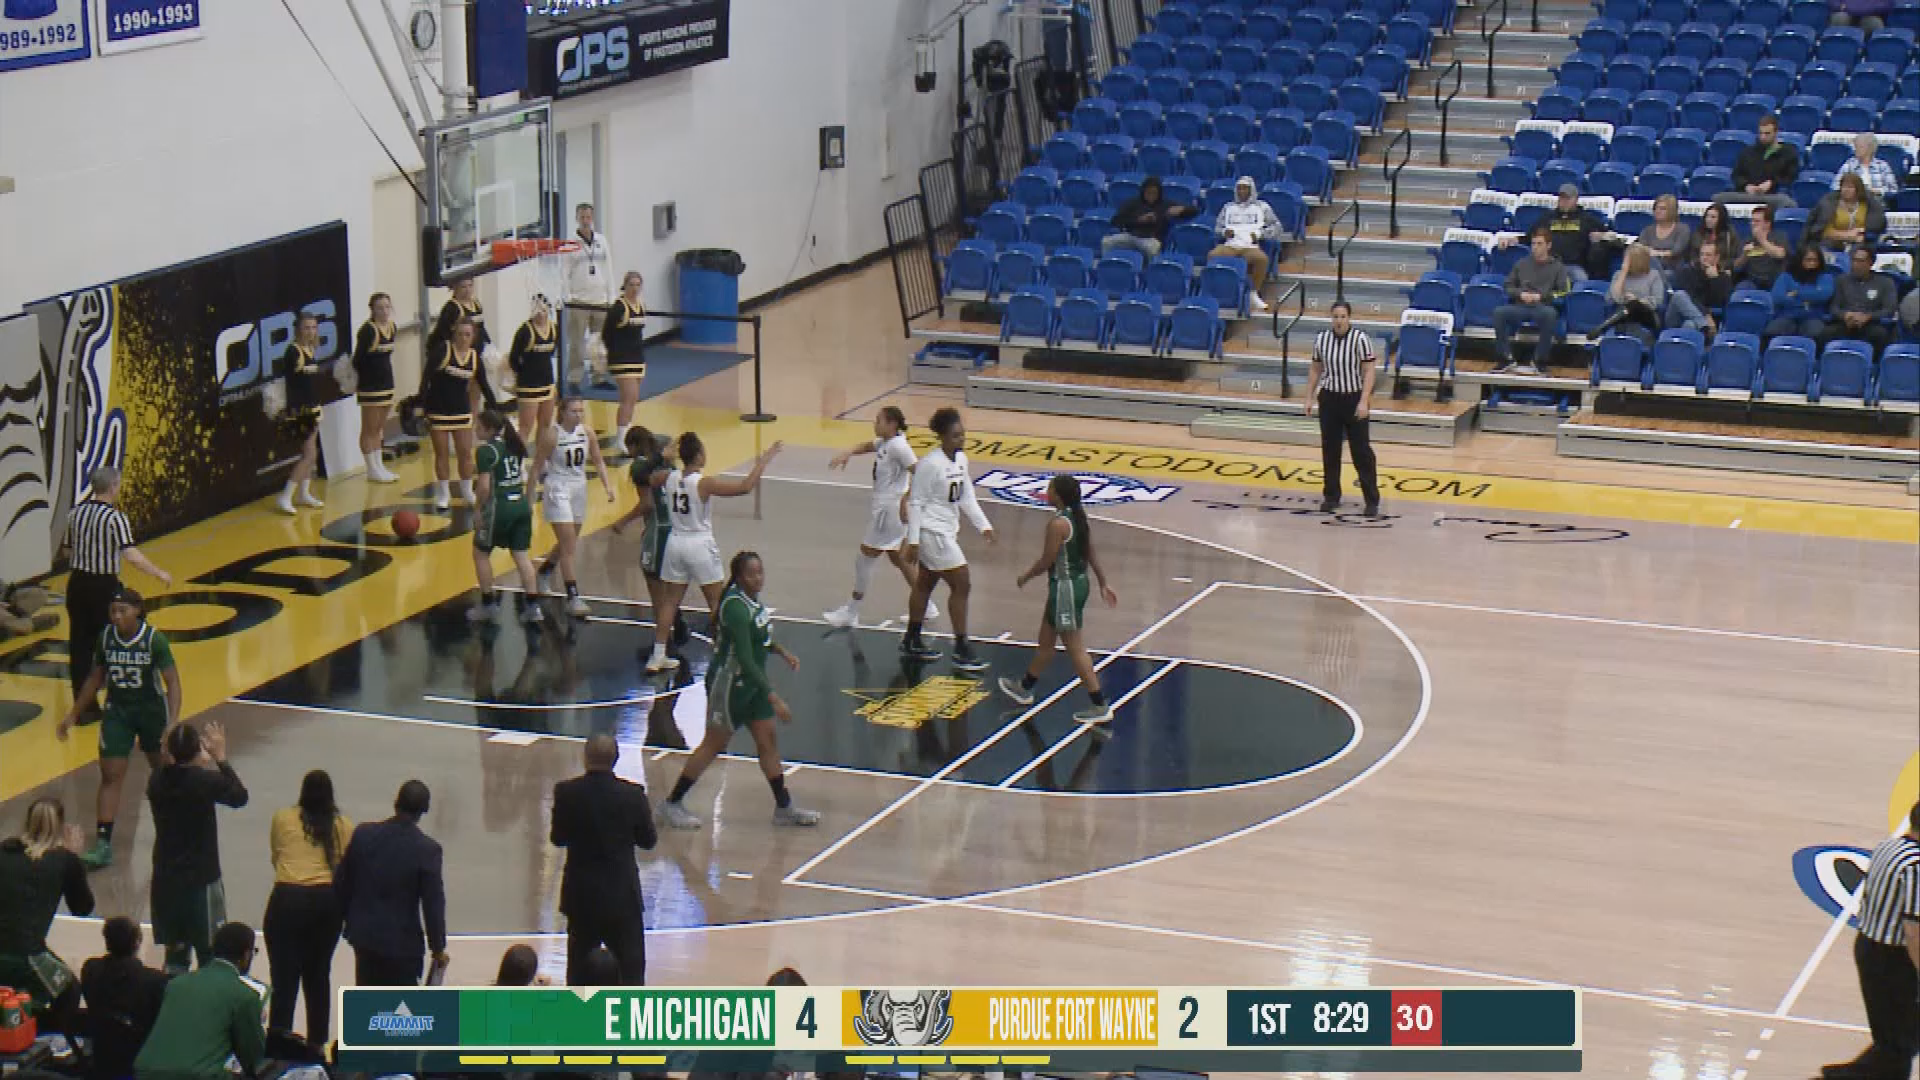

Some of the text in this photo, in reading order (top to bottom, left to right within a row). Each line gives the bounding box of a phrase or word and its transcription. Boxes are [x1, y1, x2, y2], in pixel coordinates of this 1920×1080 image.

[114, 4, 193, 33] 1990-1993
[556, 26, 630, 83] OPS
[503, 455, 520, 479] 13
[565, 447, 585, 468] 10
[672, 491, 691, 515] 13
[108, 664, 143, 689] 23
